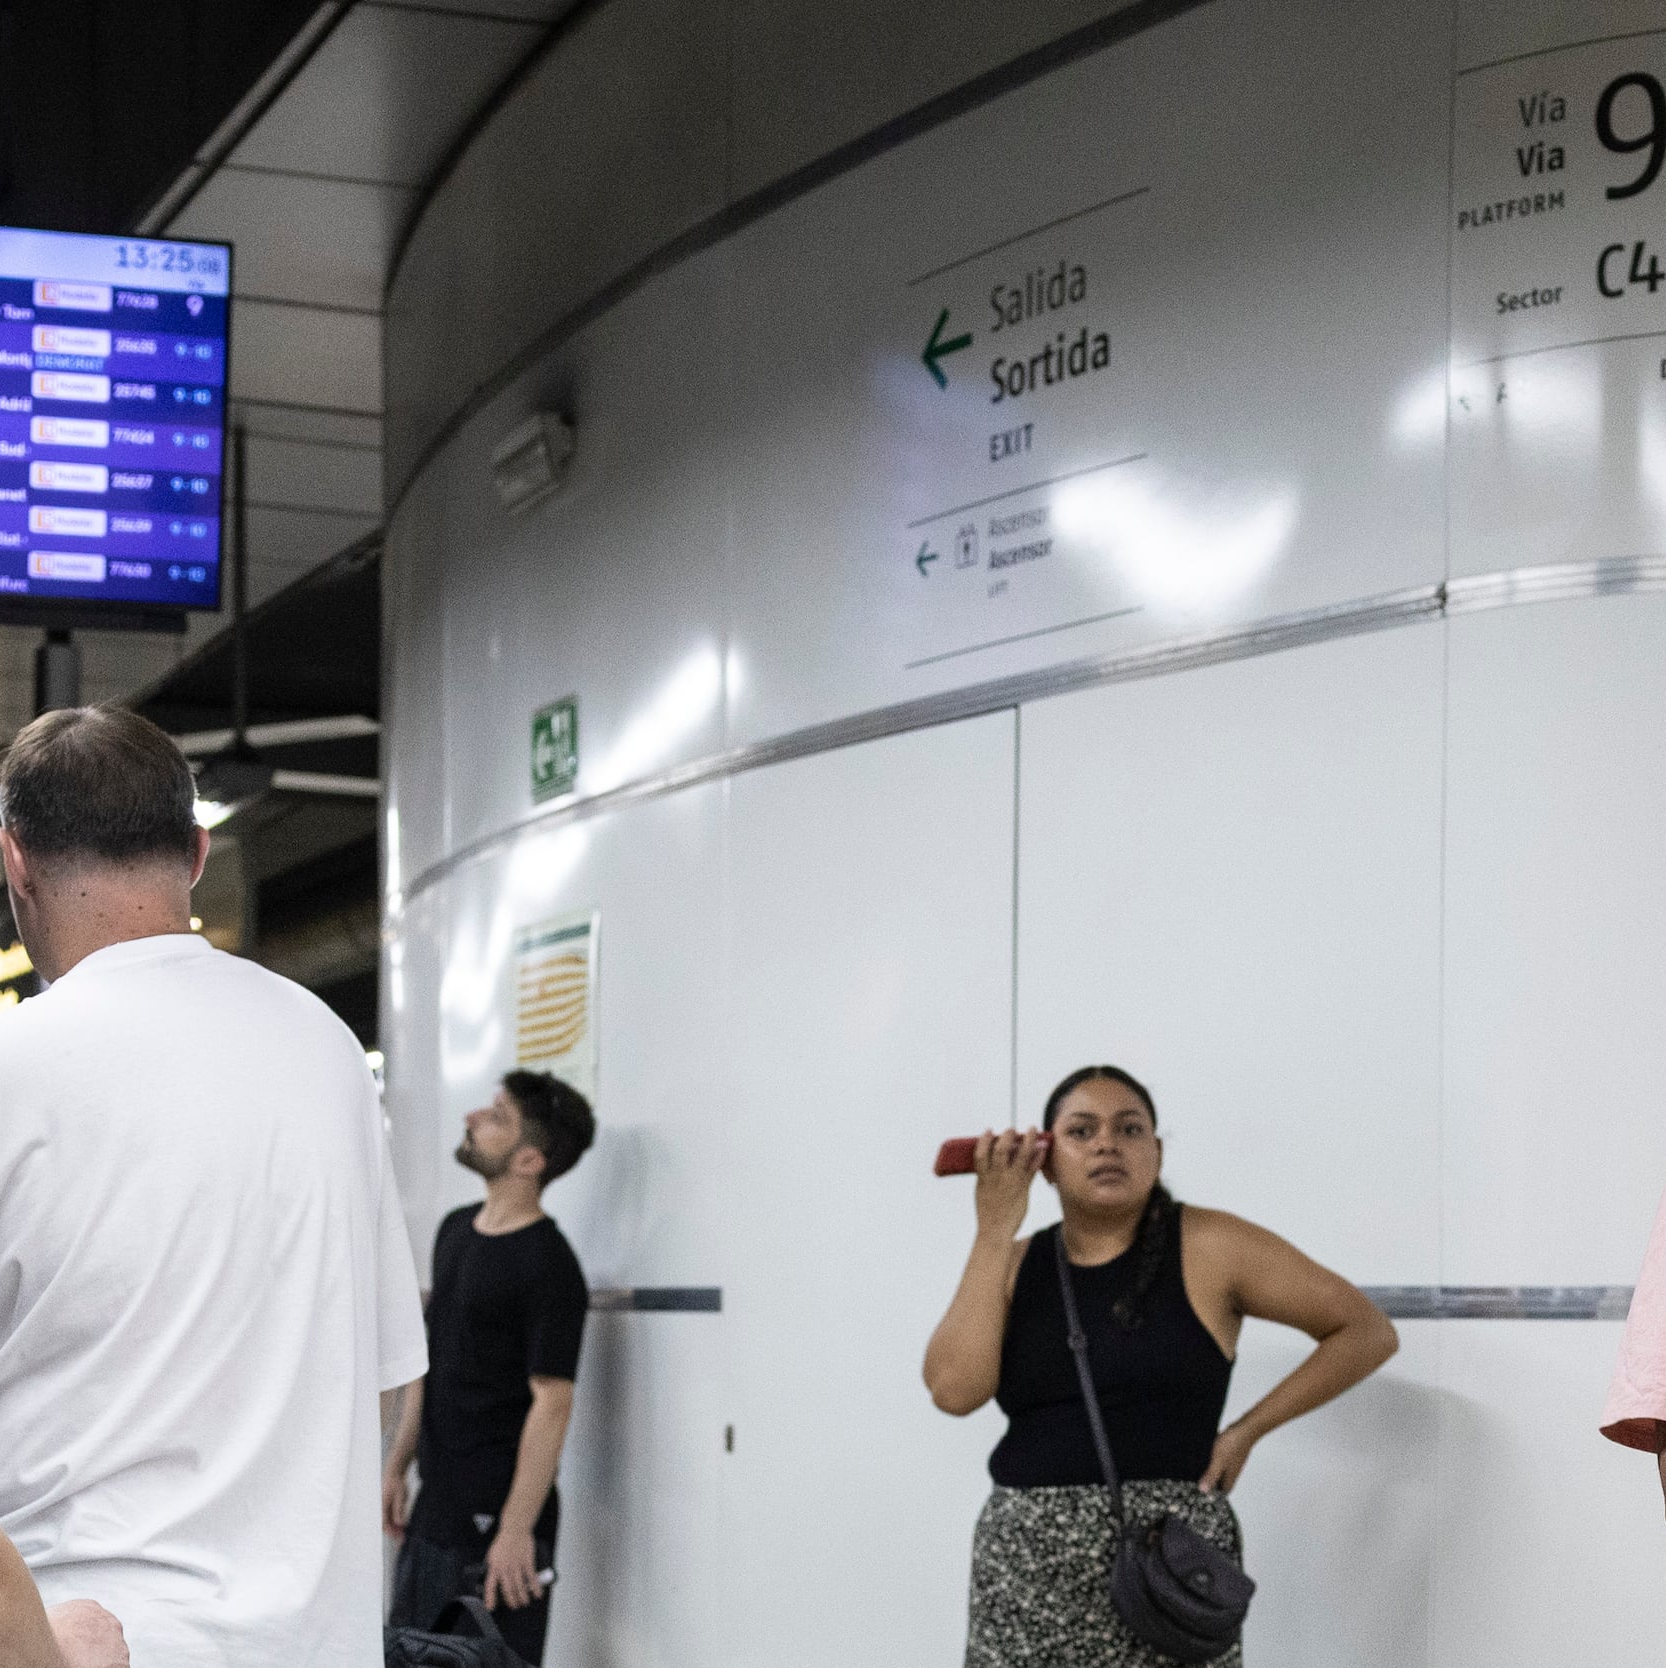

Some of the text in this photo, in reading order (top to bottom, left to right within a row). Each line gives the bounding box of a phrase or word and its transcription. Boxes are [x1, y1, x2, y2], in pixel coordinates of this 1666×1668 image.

[1516, 141, 1565, 177] Via
[1457, 191, 1566, 231] PLATFORM
[116, 244, 194, 272] 13:25
[1596, 240, 1666, 298] C4
[991, 260, 1086, 332] Salida
[1496, 286, 1563, 315] Sector
[991, 326, 1110, 404] Sortida
[990, 422, 1034, 462] EXIT
